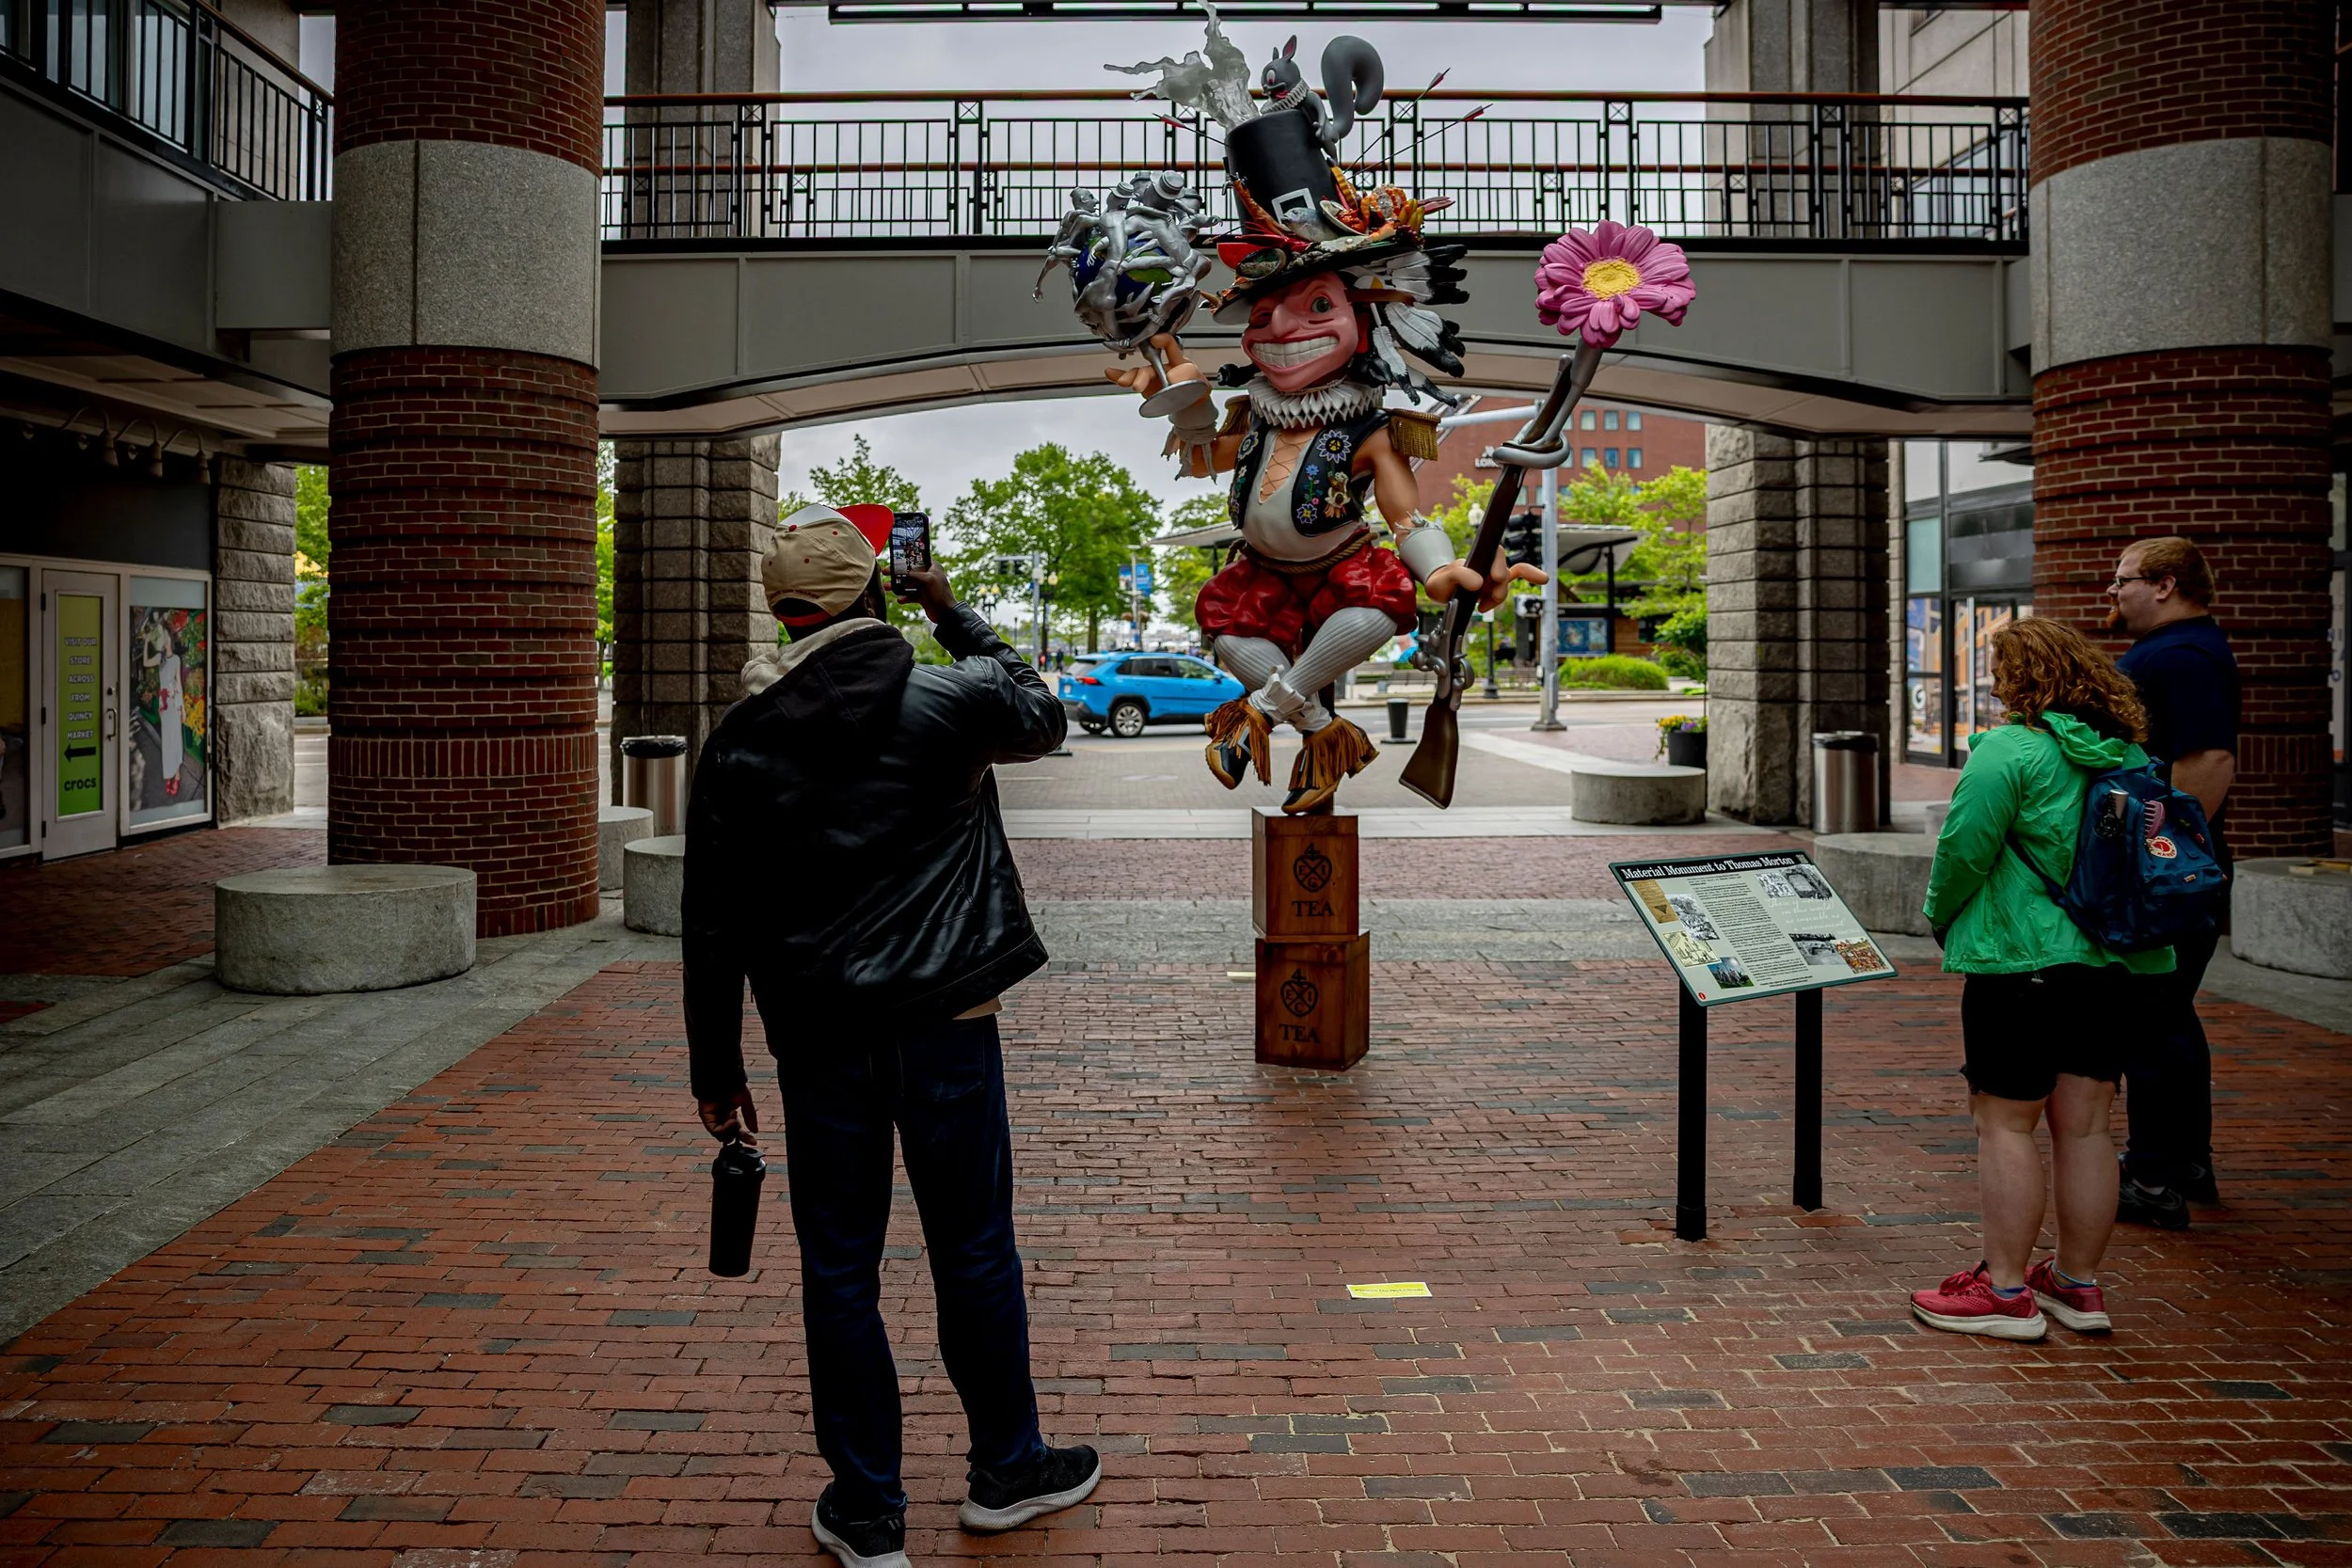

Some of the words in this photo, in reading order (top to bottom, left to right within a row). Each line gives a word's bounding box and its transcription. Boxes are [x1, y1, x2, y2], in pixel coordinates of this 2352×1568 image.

[65, 637, 81, 646] VISIT
[82, 637, 97, 646] OUR
[70, 656, 91, 665] STORE
[68, 674, 94, 684] ACROSS
[71, 692, 90, 702] FROM
[68, 711, 93, 721] QUINCY
[67, 730, 93, 739] MARKET
[64, 778, 97, 791] crocs
[1620, 864, 1665, 879] Material
[1666, 863, 1713, 877] Monument
[1714, 862, 1726, 872] to
[1724, 858, 1761, 871] Thomas
[1760, 856, 1795, 867] Morton
[1292, 900, 1335, 917] TEA
[1279, 1023, 1321, 1044] TEA
